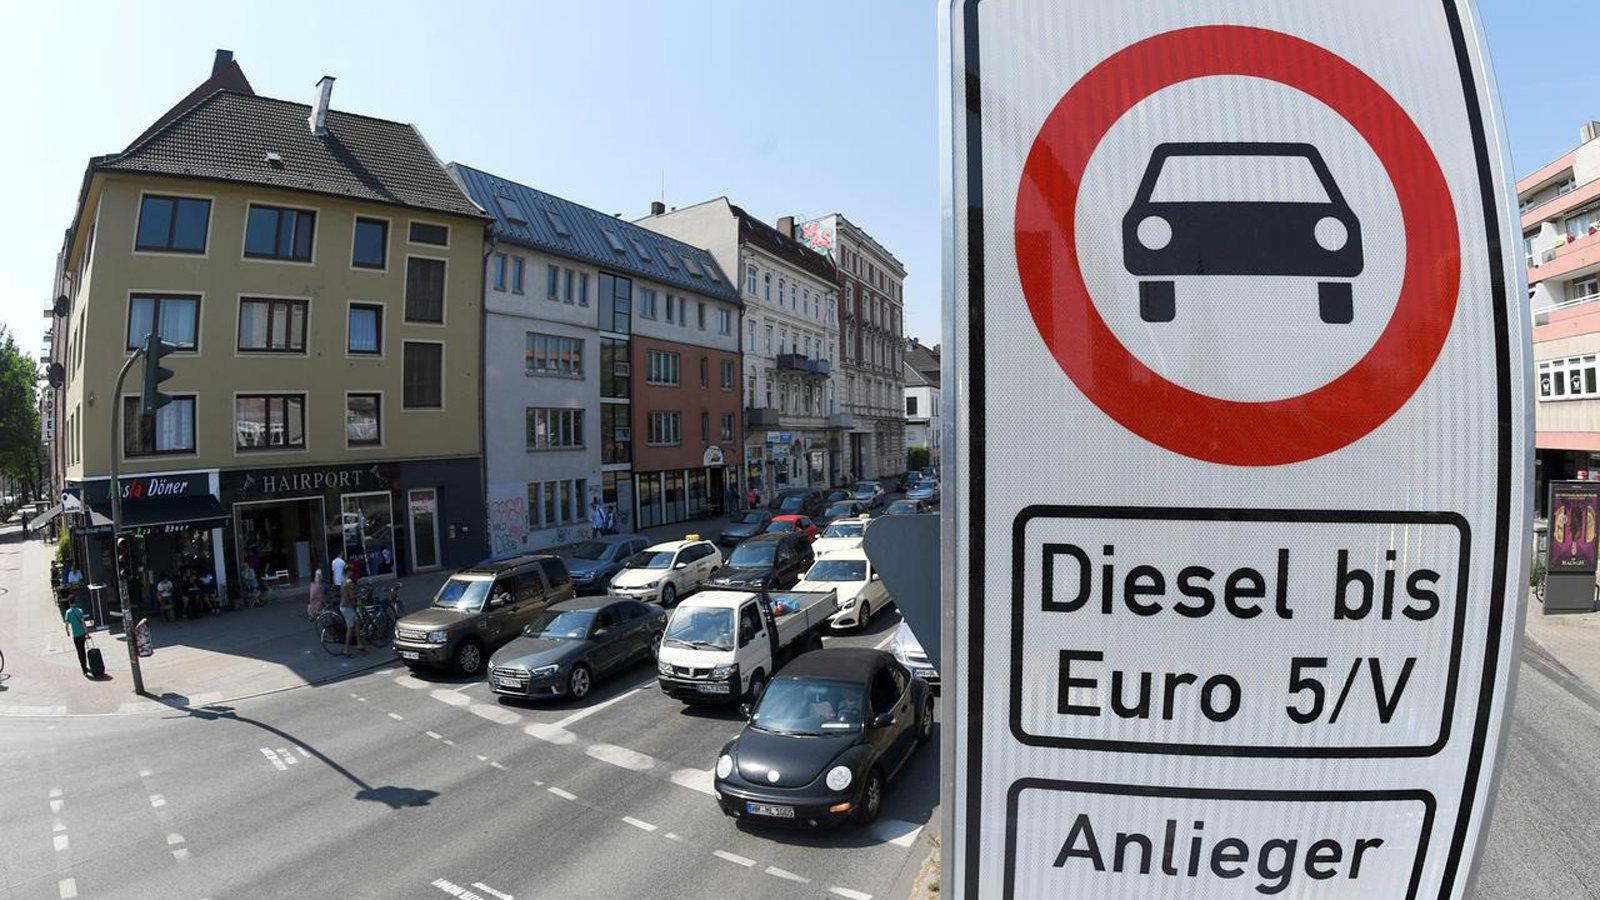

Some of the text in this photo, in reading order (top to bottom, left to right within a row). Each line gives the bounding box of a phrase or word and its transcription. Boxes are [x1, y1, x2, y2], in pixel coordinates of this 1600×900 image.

[147, 478, 189, 497] Döner
[262, 470, 363, 493] HAIRPORT
[1041, 543, 1441, 621] Diesel bis
[1057, 649, 1417, 724] Euro 5/V
[1052, 813, 1384, 895] Anlieger
